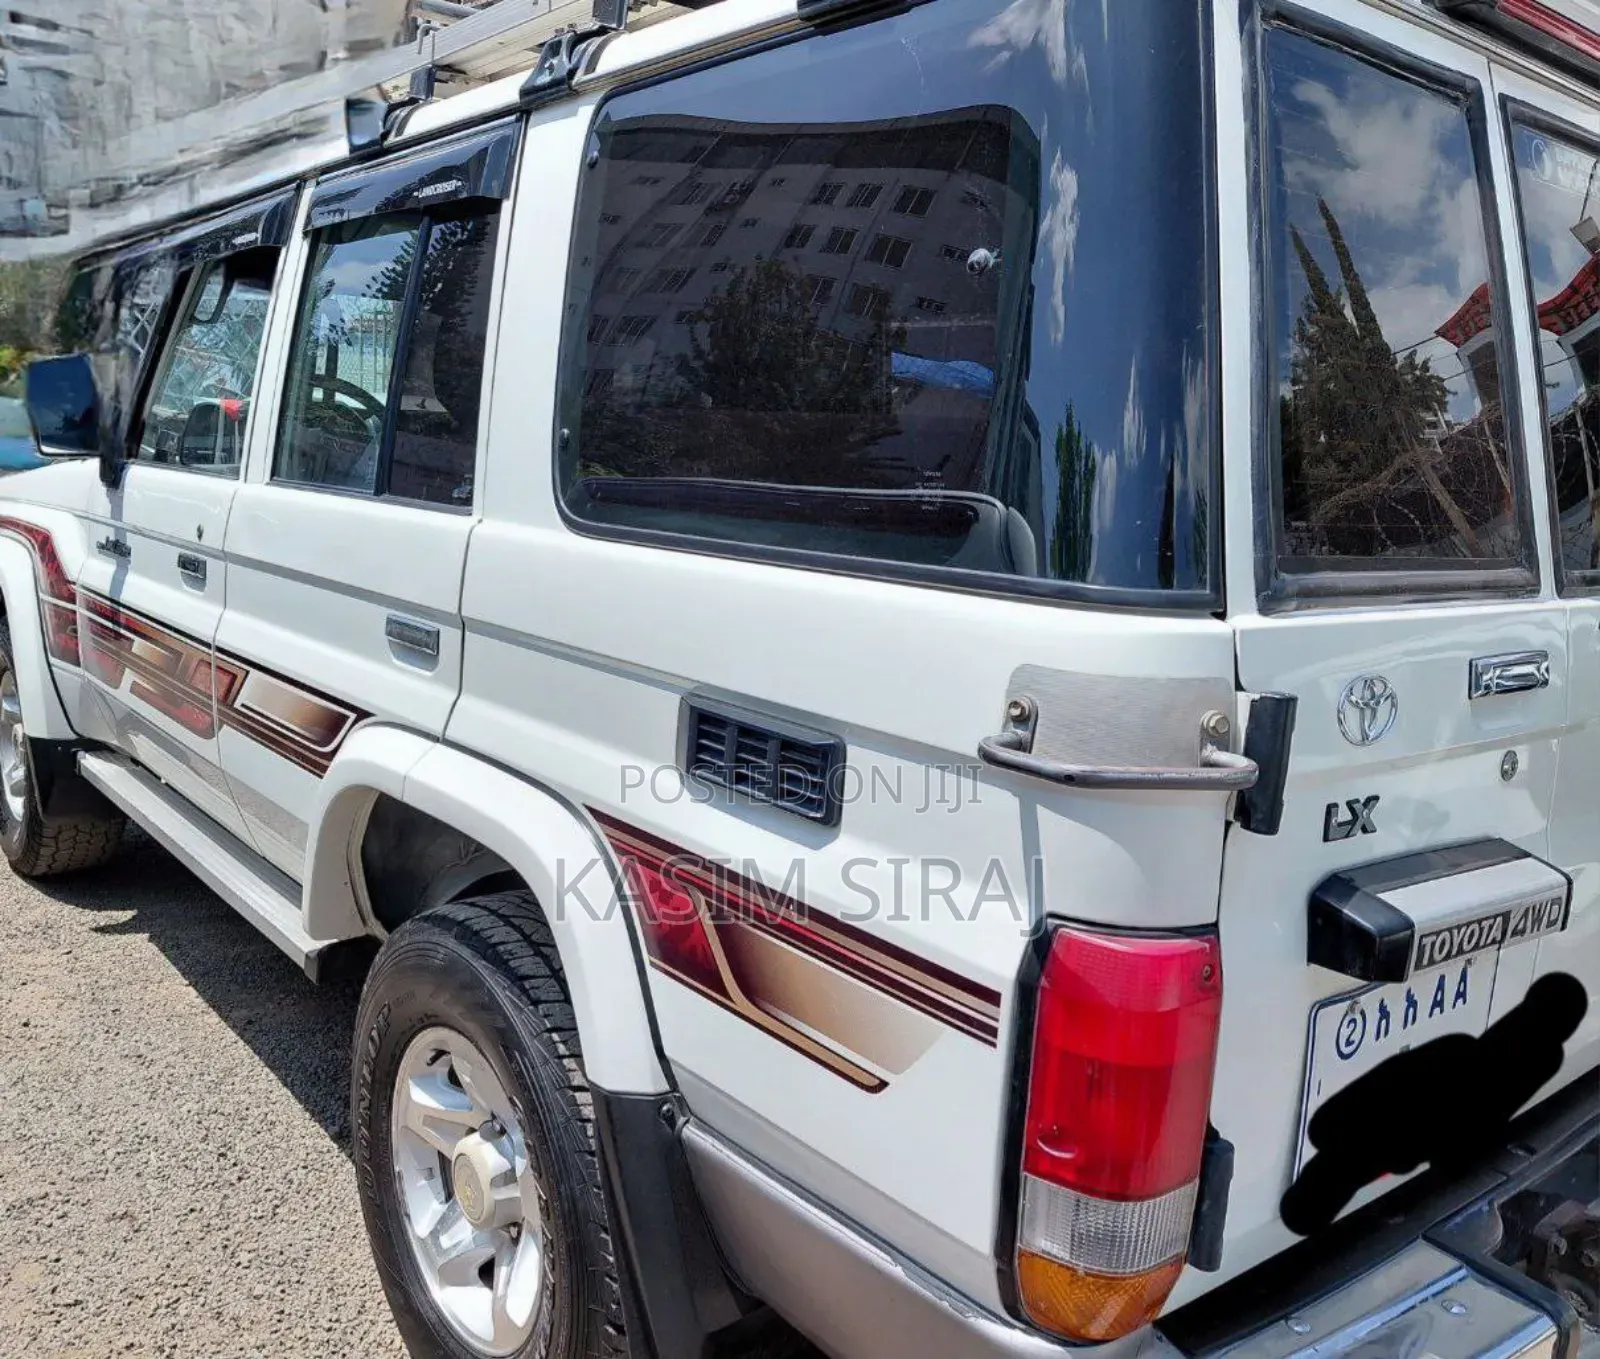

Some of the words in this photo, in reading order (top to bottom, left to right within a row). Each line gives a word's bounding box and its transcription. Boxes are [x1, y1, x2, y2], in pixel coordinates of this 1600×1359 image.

[1323, 795, 1380, 842] LX
[1421, 918, 1503, 965] TOYOTA
[1509, 897, 1562, 937] 4WD
[1428, 967, 1468, 1018] AA
